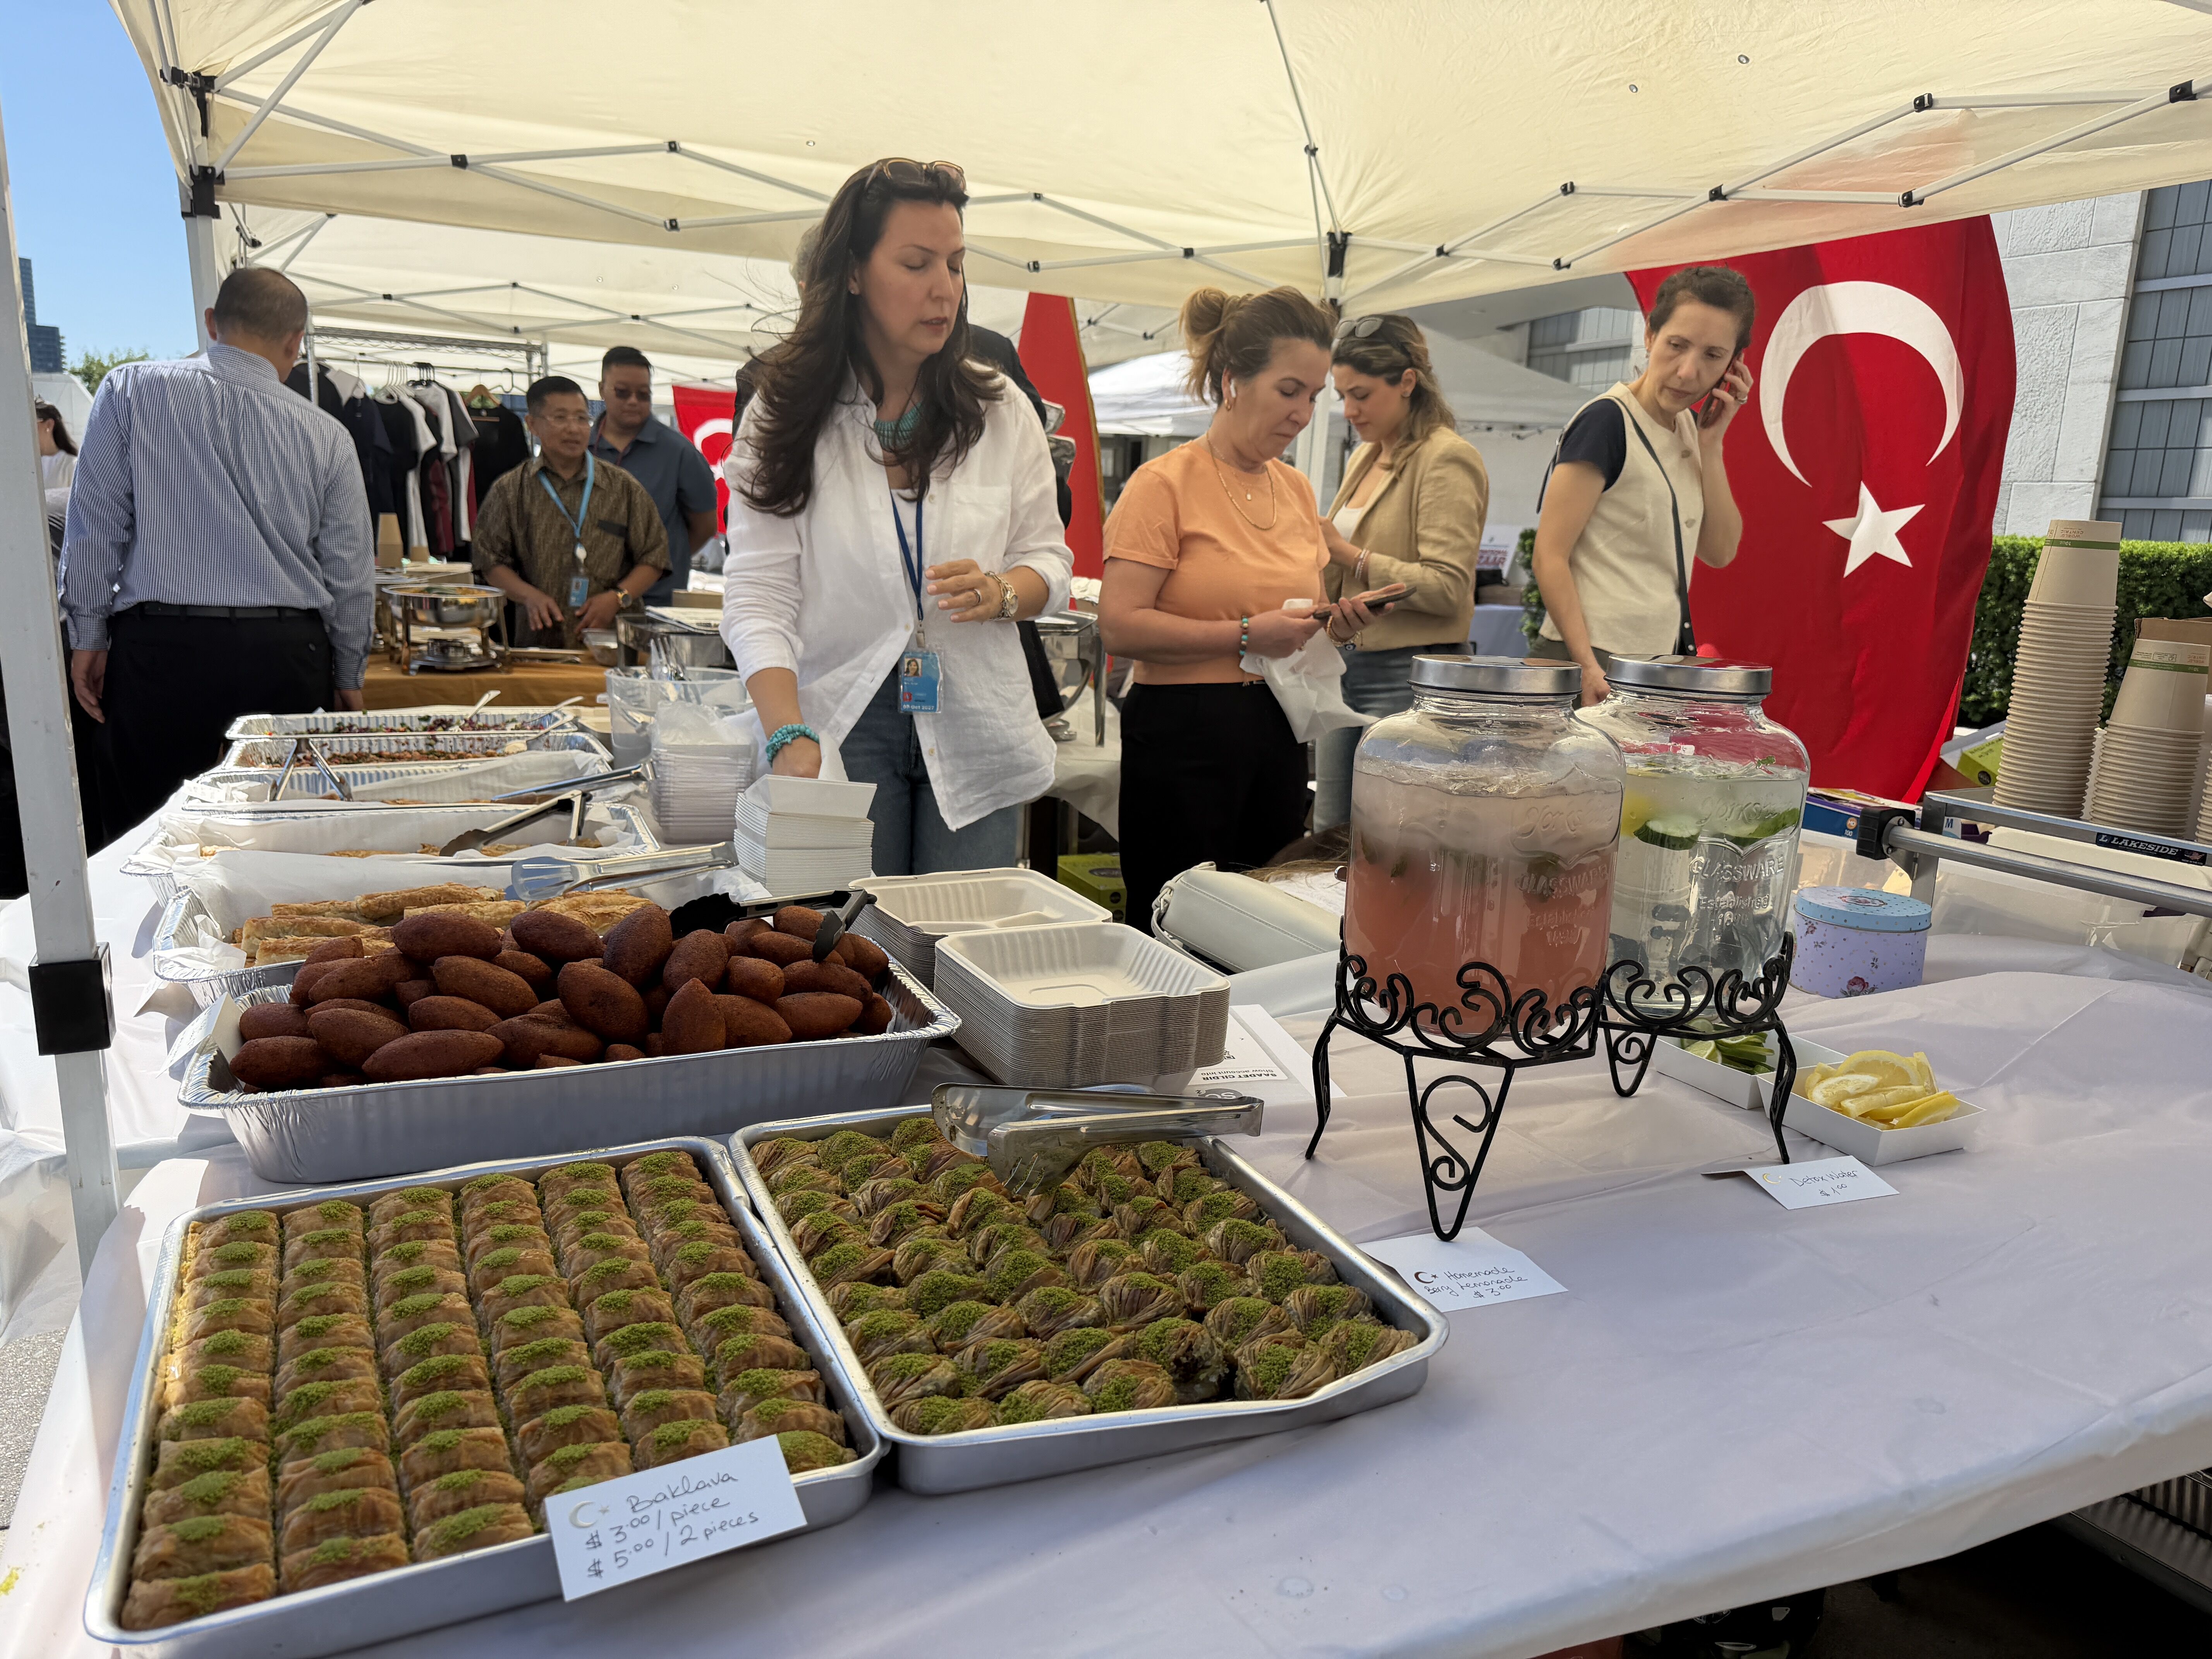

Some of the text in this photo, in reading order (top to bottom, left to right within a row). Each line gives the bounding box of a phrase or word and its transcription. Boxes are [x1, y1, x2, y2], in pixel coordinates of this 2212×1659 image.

[1844, 829, 1853, 837] 100
[2111, 837, 2179, 856] LAKESIDE
[1690, 854, 1784, 883] GLASSWARE
[1699, 893, 1770, 910] Established
[1789, 1170, 1858, 1187] Detox Water
[1444, 1266, 1515, 1281] Homemade
[1456, 1275, 1528, 1290] Lemonade
[627, 1472, 738, 1513] Baklava
[704, 1511, 759, 1541] pieces
